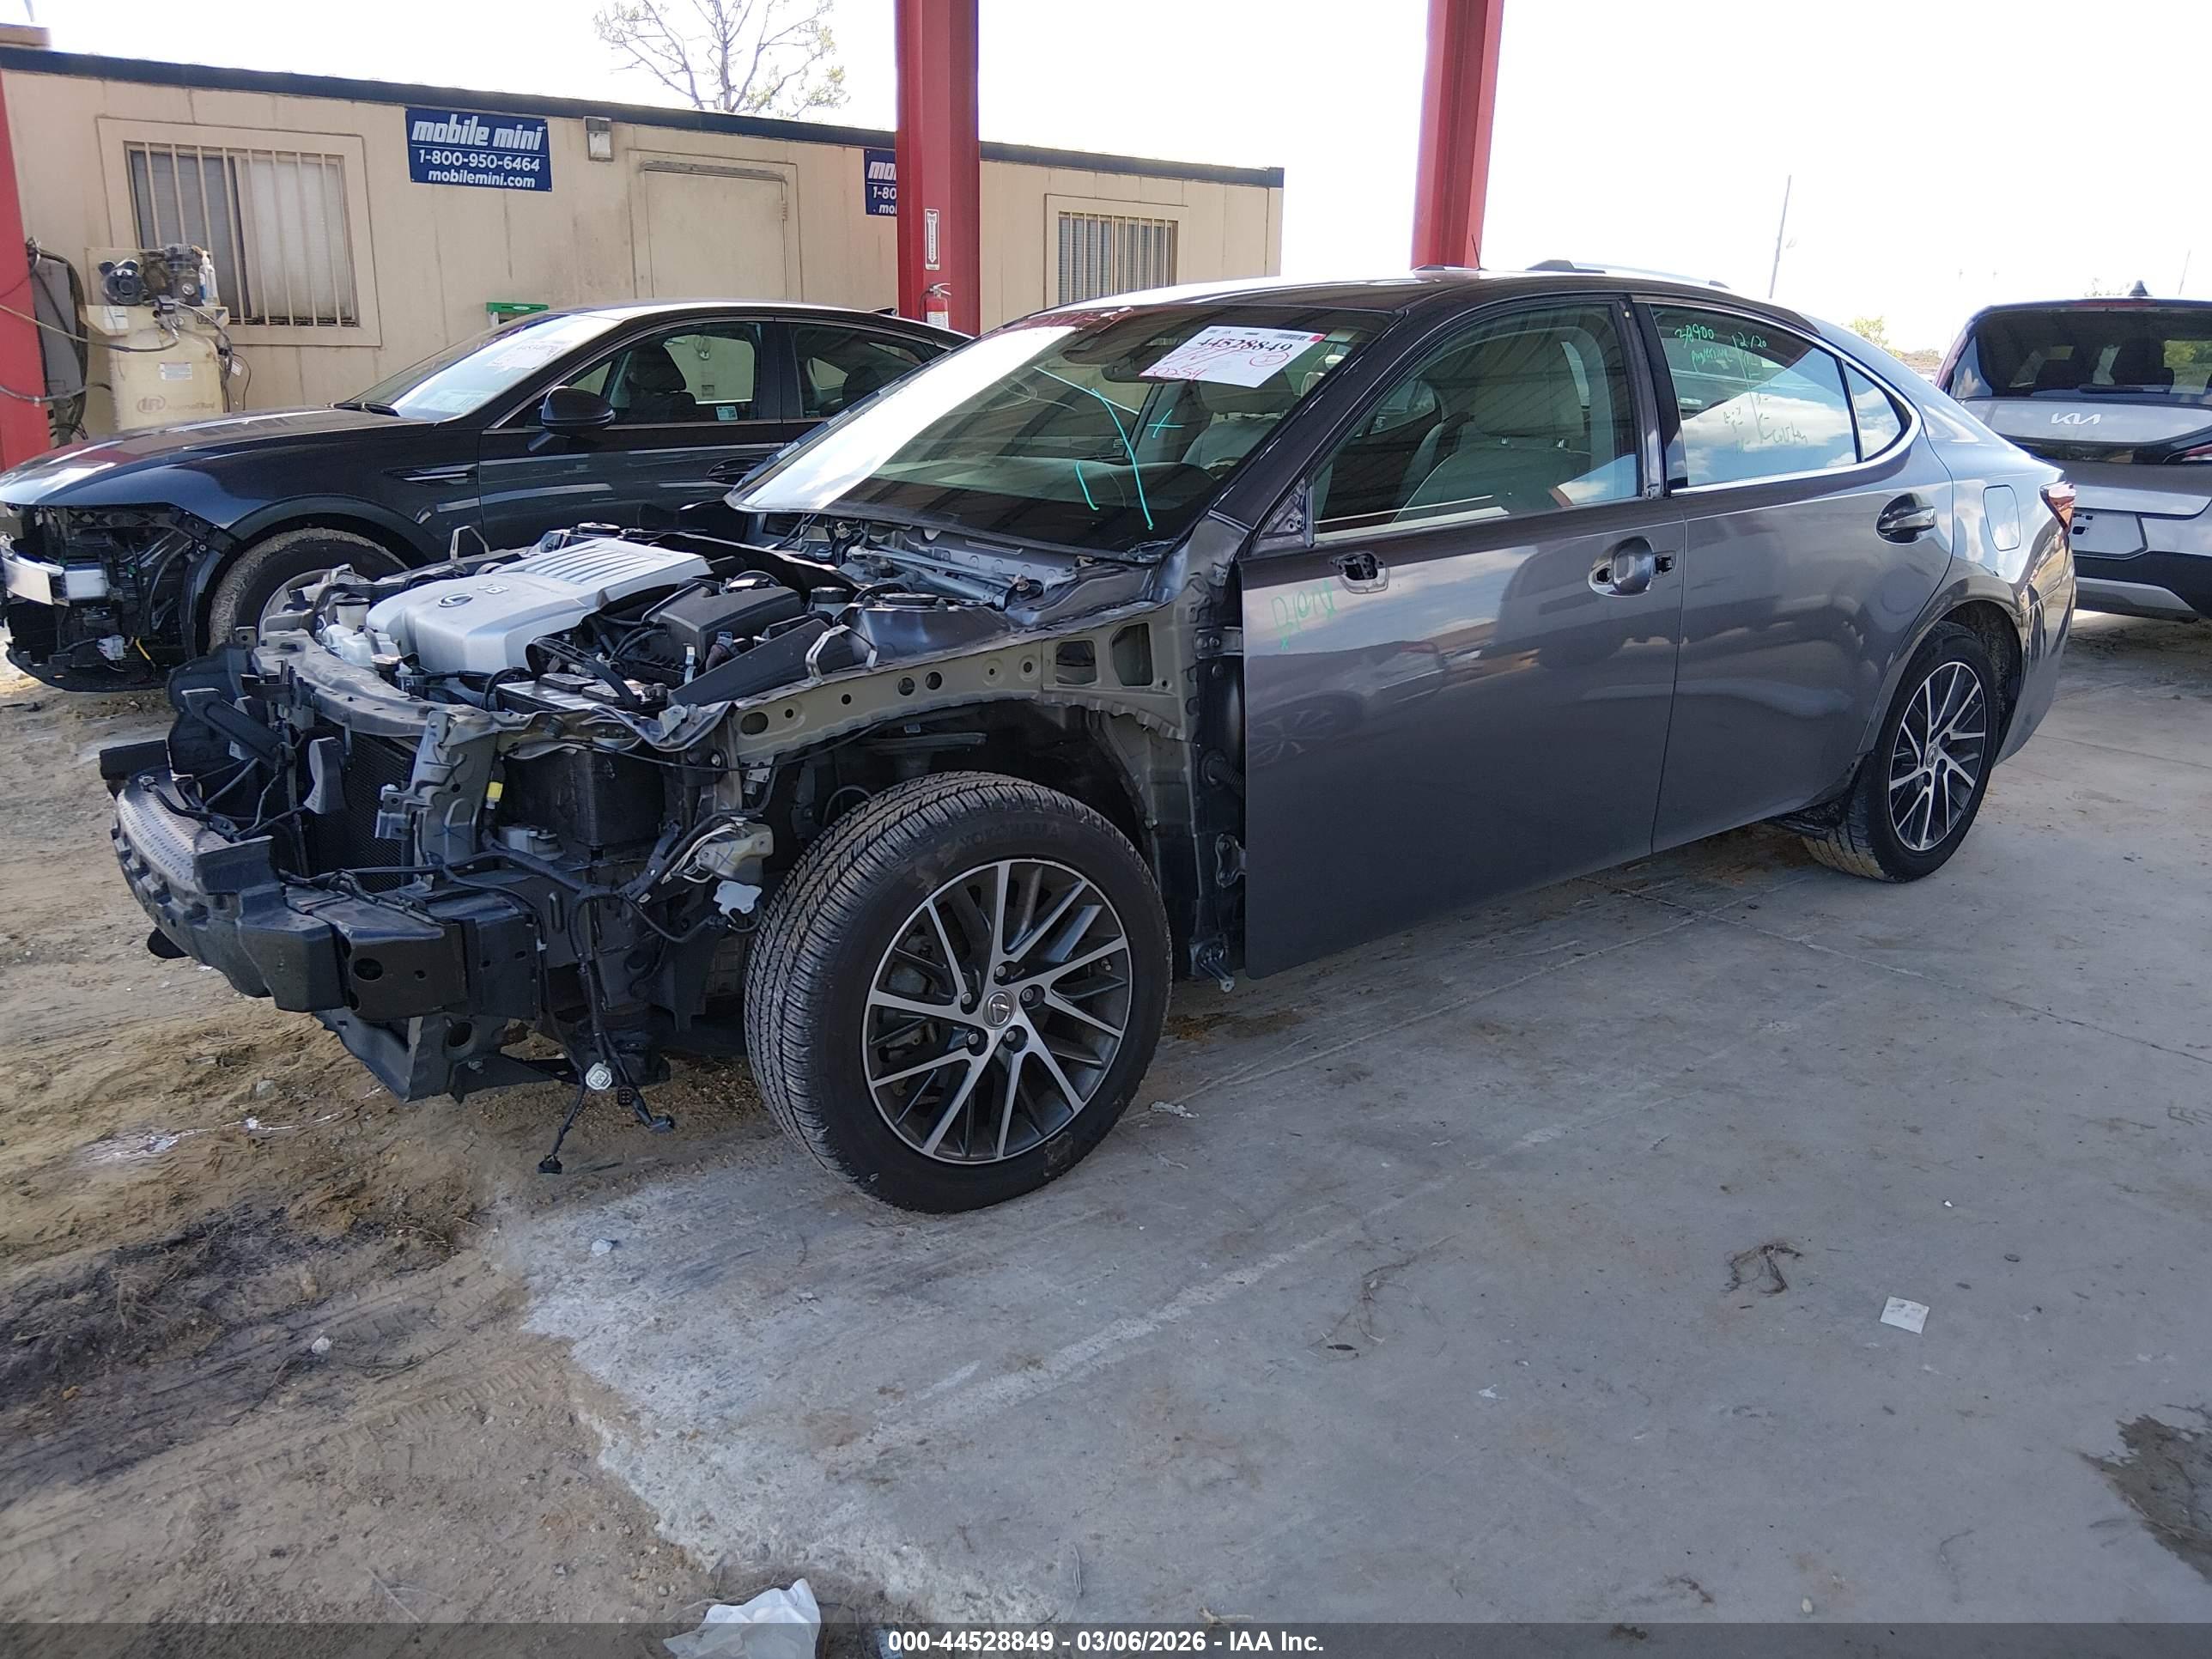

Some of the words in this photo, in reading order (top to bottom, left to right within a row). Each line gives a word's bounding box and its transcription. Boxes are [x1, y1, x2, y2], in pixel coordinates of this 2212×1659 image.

[411, 113, 489, 146] mobile
[492, 125, 544, 151] mini
[419, 149, 540, 172] 1-800-950-6464
[428, 169, 536, 188] mobilemini.com
[867, 161, 896, 180] mo
[1197, 337, 1293, 352] 44528849
